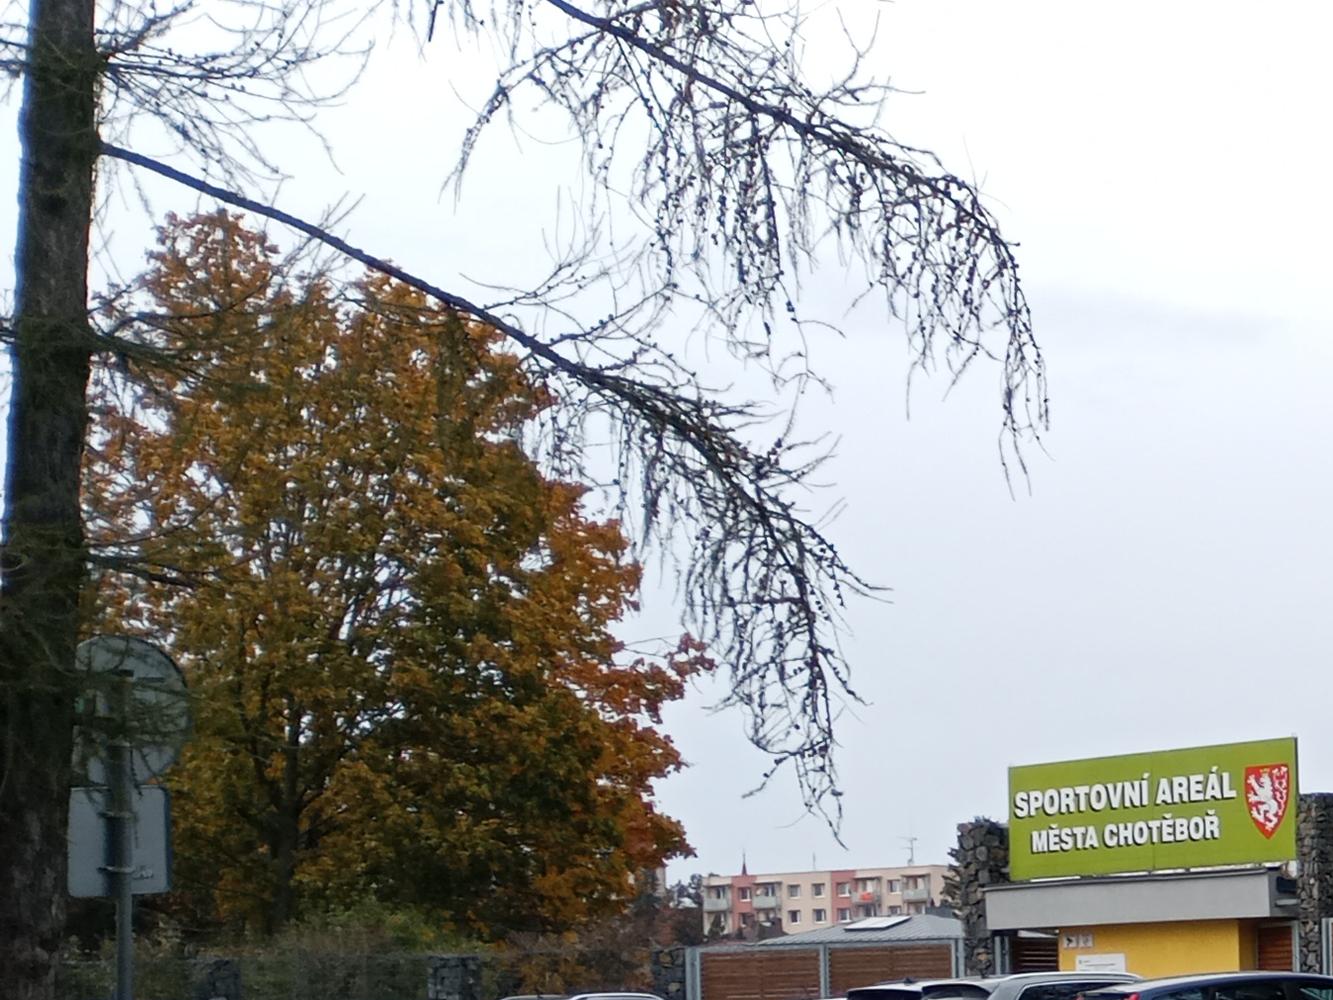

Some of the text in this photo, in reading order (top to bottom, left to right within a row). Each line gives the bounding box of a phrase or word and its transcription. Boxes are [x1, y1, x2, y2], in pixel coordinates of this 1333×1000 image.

[1014, 766, 1237, 818] SPORTOVNÍ AREÁL
[1031, 809, 1219, 854] MĚSTA CHOTĚBOŘ
